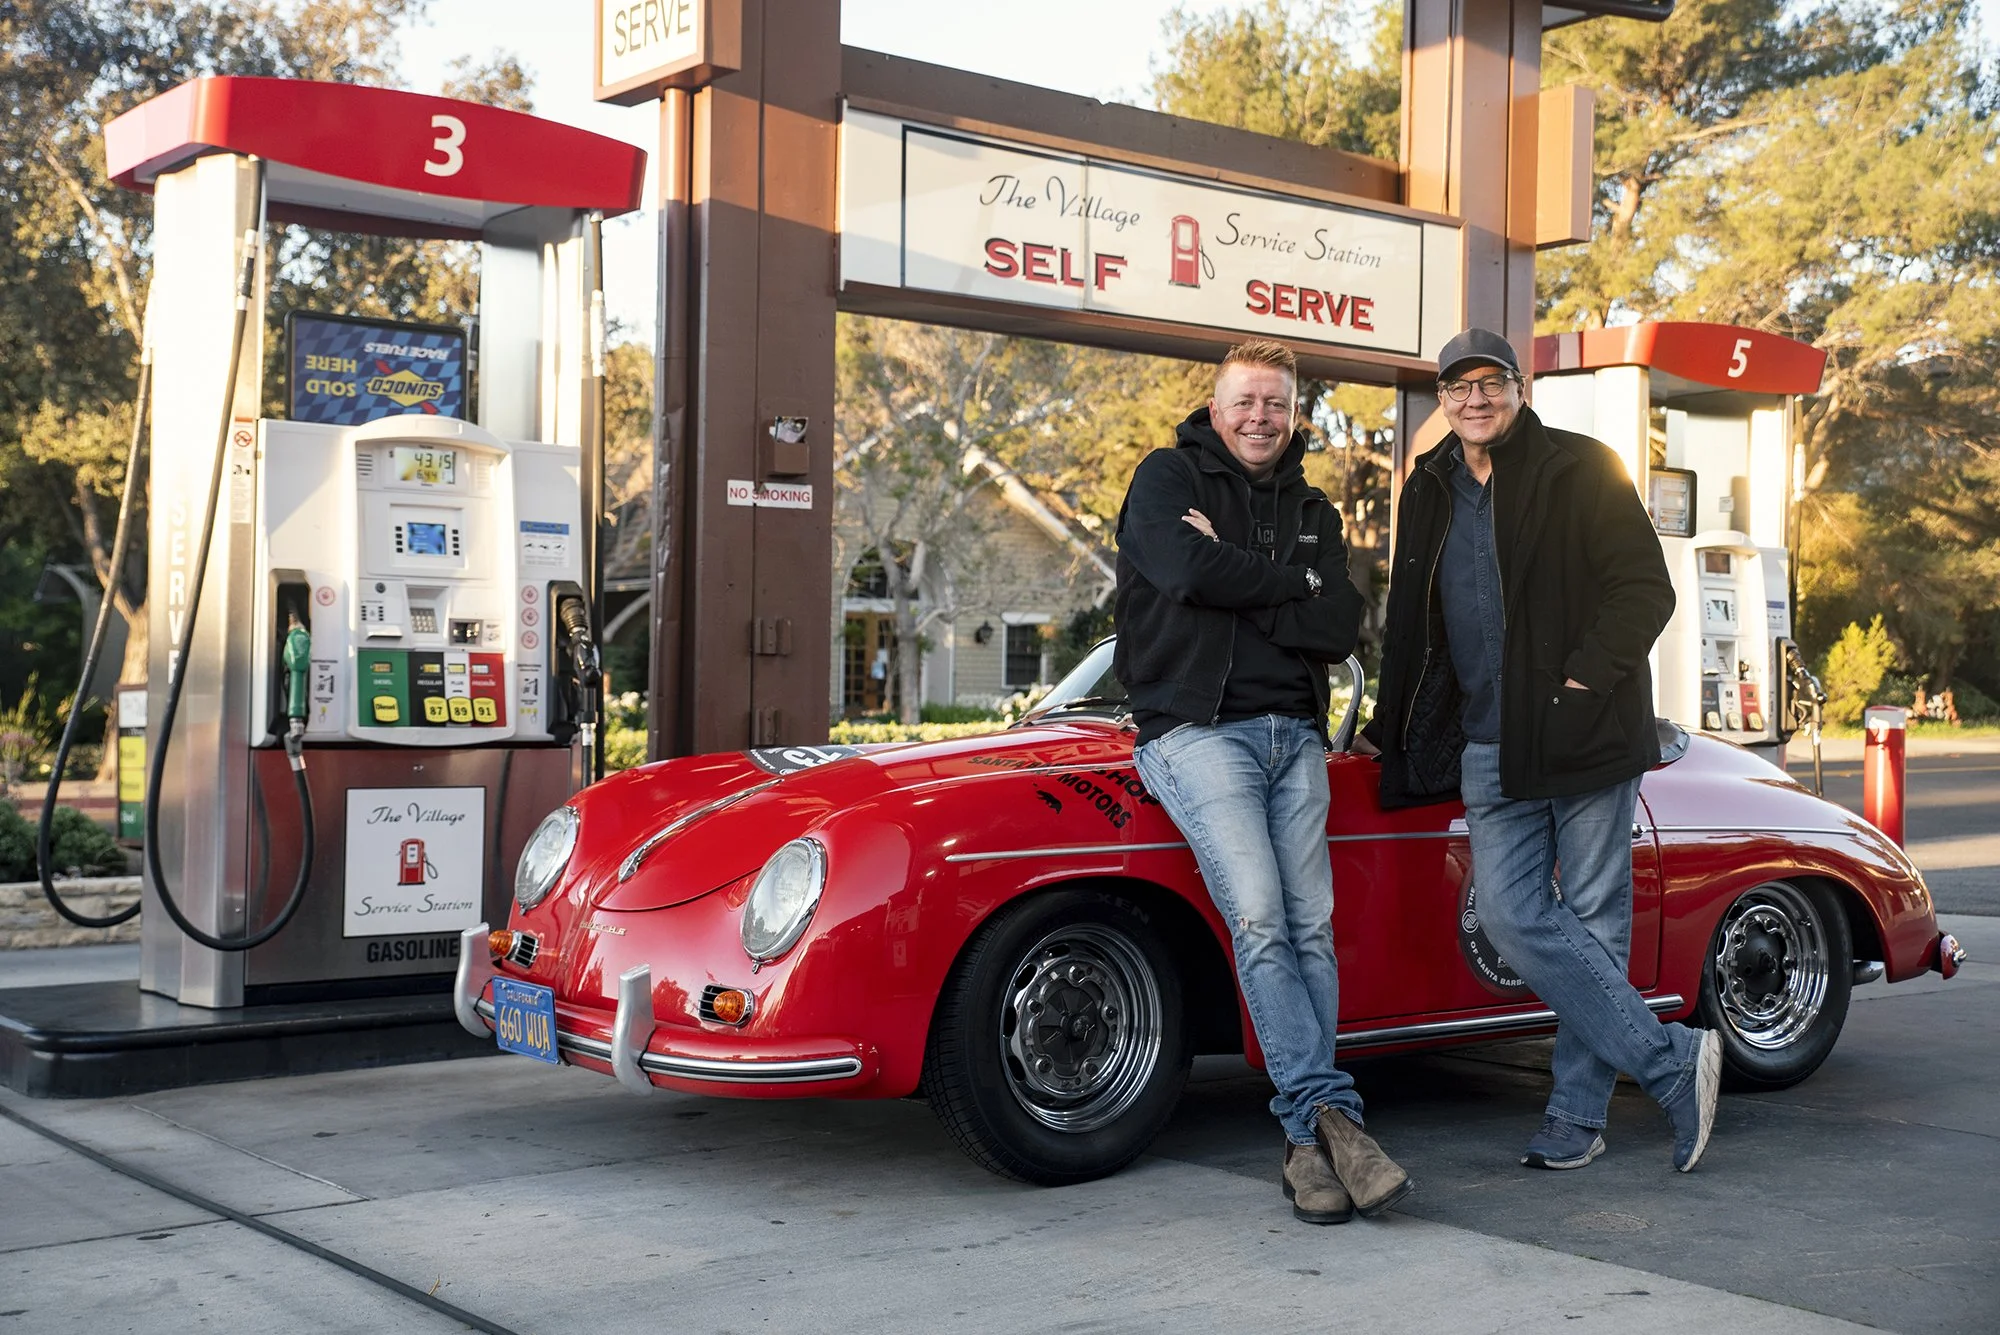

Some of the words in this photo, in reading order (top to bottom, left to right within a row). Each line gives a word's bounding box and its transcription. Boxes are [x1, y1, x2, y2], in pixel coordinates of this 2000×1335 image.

[614, 0, 690, 57] SERVE
[424, 114, 467, 176] 3
[979, 175, 1036, 209] The
[1046, 176, 1140, 232] Village
[1216, 212, 1296, 254] Service
[1304, 228, 1381, 268] Station
[984, 237, 1128, 291] SELF
[1246, 279, 1374, 332] SERVE
[363, 342, 410, 357] FUELS
[410, 348, 449, 361] RACE
[1727, 338, 1753, 378] 5
[305, 355, 357, 373] HERE
[305, 378, 357, 397] SOLD
[370, 378, 441, 397] SUNOCO
[729, 487, 748, 499] NO
[752, 488, 811, 503] SMOKING
[429, 706, 443, 716] 87
[453, 706, 468, 716] 89
[478, 706, 492, 716] 91
[968, 755, 1026, 770] SANTA
[1057, 772, 1133, 829] MOTORS
[366, 806, 402, 825] The
[407, 802, 466, 826] Village
[353, 896, 412, 917] Service
[417, 893, 473, 914] Station
[366, 937, 460, 963] GASOLINE
[1470, 940, 1479, 955] OF
[1476, 956, 1498, 982] SANTA
[1499, 977, 1526, 987] BARB
[506, 989, 540, 1007] CALIFORNIA
[499, 1005, 522, 1044] 660
[525, 1011, 551, 1052] WUA
